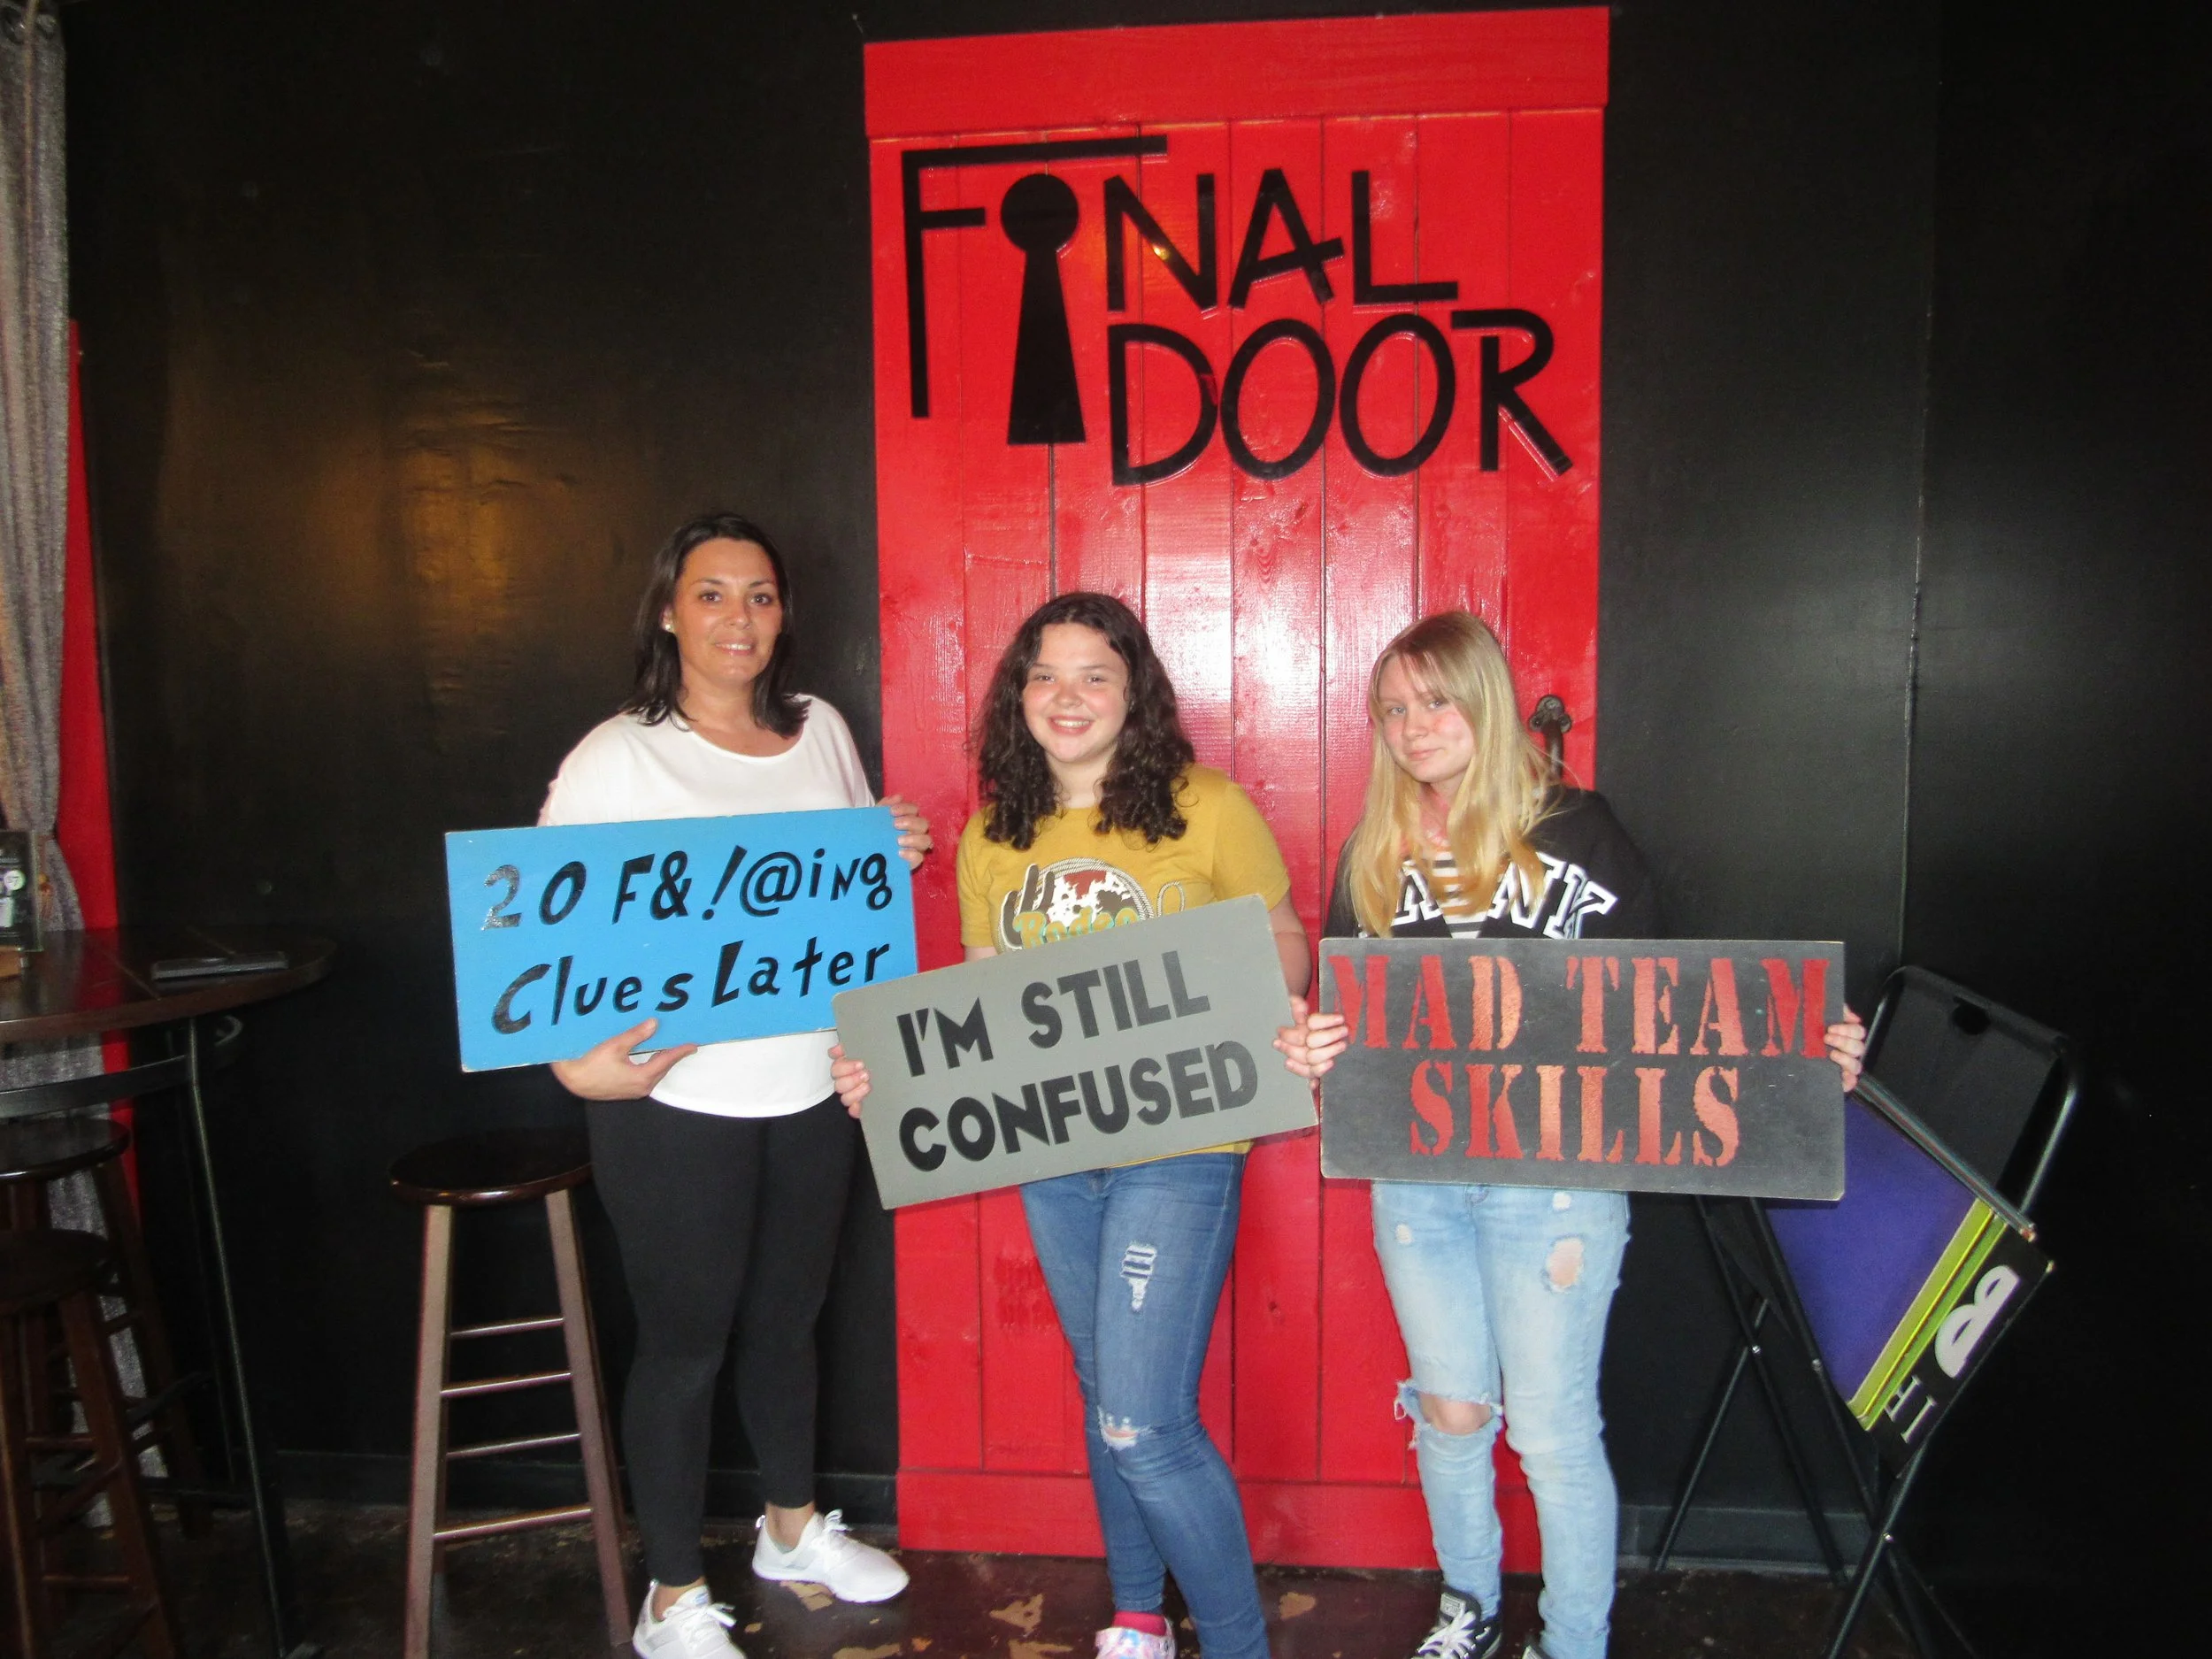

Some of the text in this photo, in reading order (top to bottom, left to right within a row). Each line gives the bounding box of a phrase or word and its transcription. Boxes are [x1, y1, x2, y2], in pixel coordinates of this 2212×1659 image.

[902, 134, 1458, 446] FINAL
[1107, 308, 1574, 487] DOOR
[480, 861, 588, 931] 20
[491, 935, 891, 1035] Clues Later
[895, 950, 1212, 1078] I'M STILL
[1328, 955, 1831, 1059] MAD TEAM
[898, 1040, 1259, 1172] CONFUSED
[1409, 1061, 1741, 1167] SKILLS
